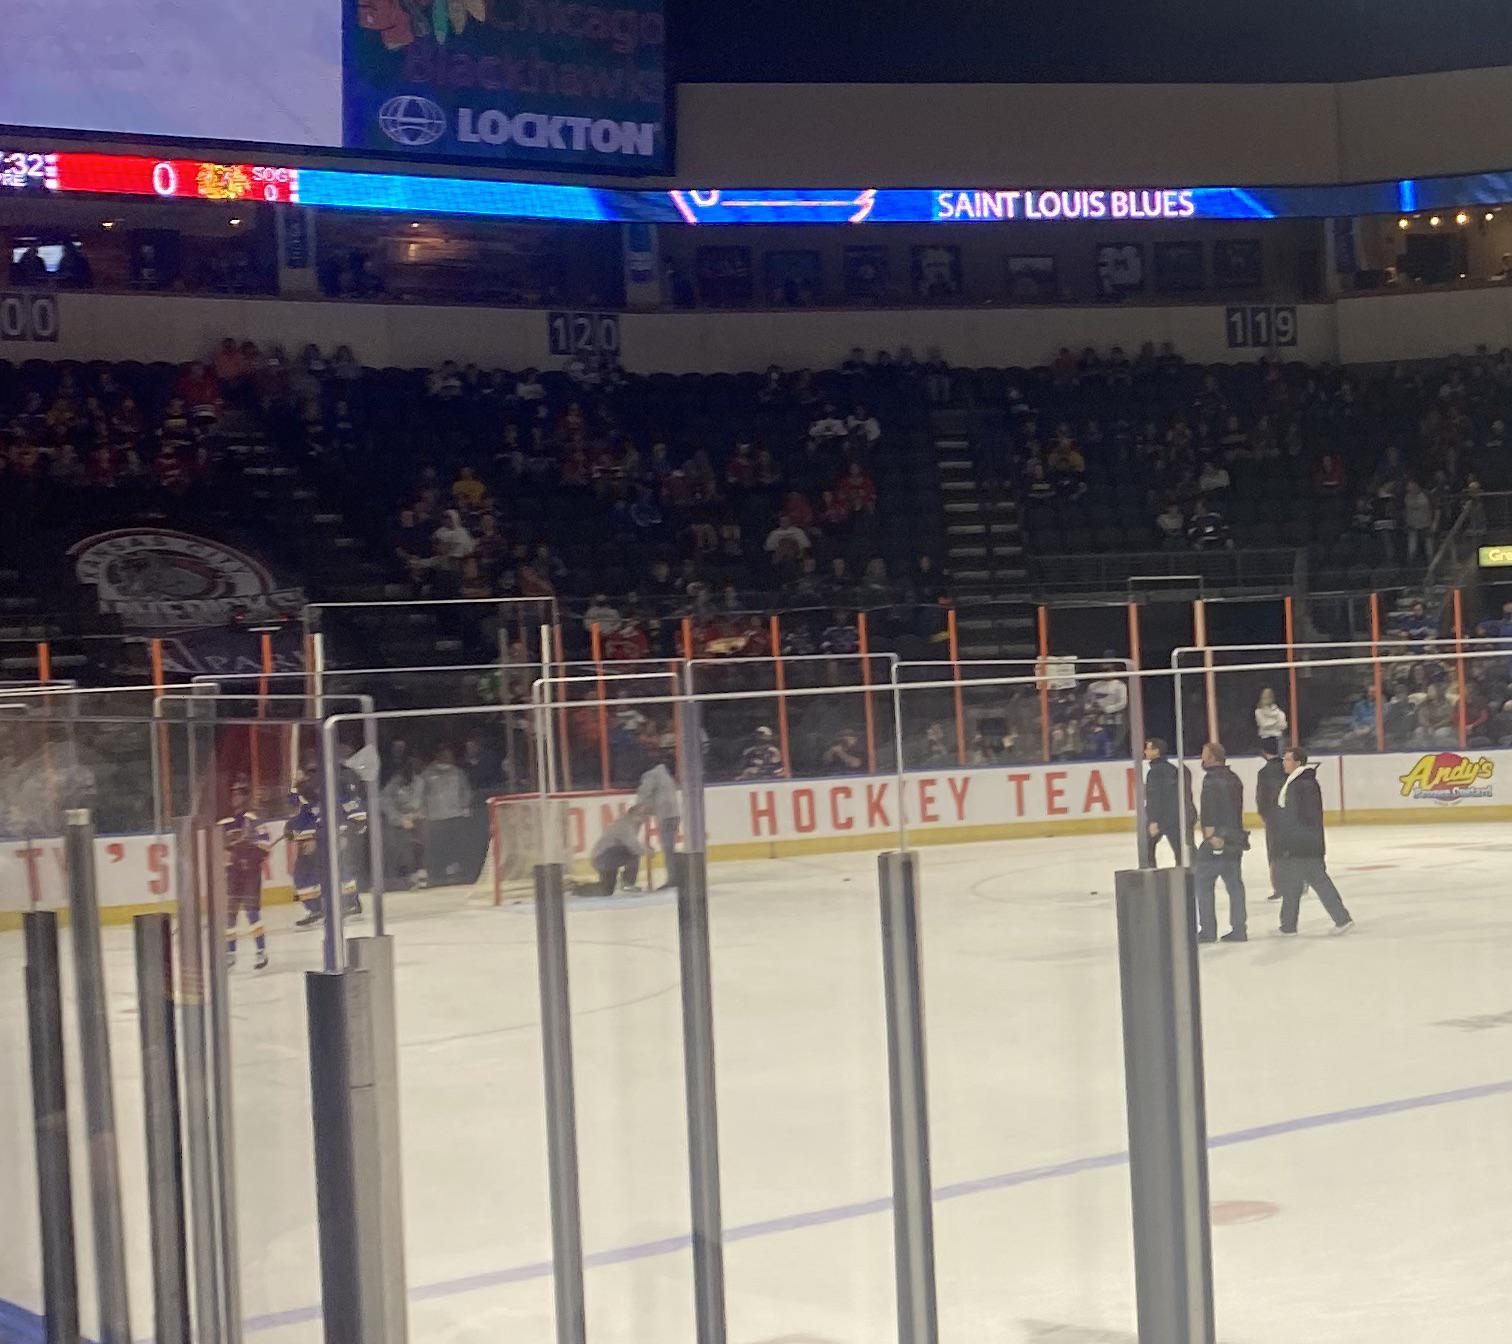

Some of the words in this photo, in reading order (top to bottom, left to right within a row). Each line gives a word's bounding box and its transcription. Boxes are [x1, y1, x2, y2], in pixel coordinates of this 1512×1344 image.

[457, 107, 654, 156] LOCKTON
[153, 161, 176, 196] 0
[251, 166, 290, 183] SOG
[938, 190, 1020, 219] SAINT
[1024, 189, 1106, 219] LOUIS
[1111, 190, 1195, 218] BLUES
[553, 317, 619, 352] 120
[1230, 311, 1295, 344] 119
[1399, 754, 1494, 797] Andy's
[748, 775, 972, 837] HOCKEY
